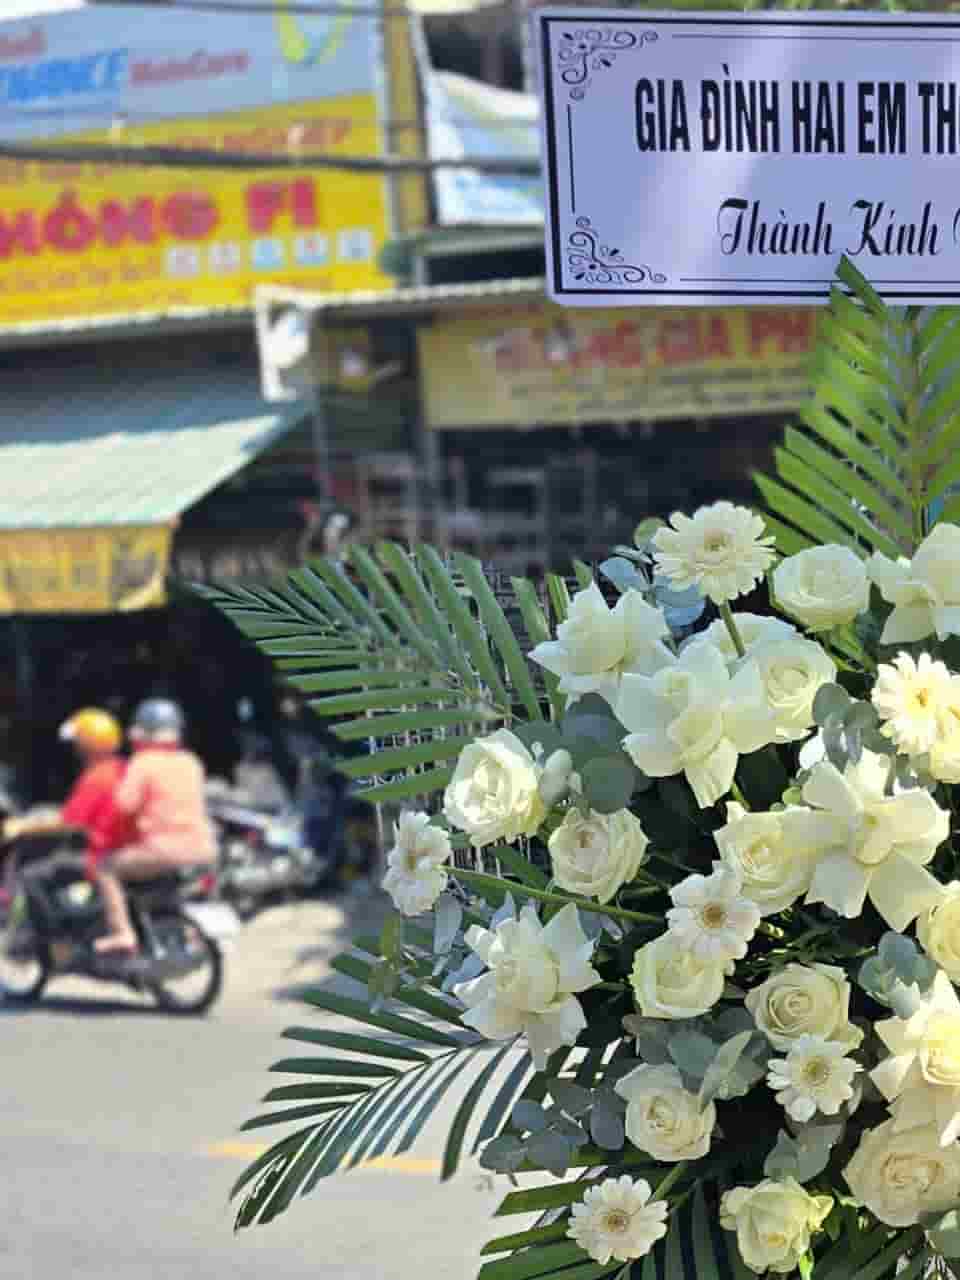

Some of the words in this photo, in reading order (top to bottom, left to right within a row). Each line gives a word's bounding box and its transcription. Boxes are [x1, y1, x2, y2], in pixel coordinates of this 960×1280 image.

[635, 77, 691, 152] GIA
[700, 63, 781, 153] ĐÌNH
[792, 80, 846, 153] HAI
[857, 81, 907, 154] EM
[717, 198, 836, 256] Thành
[848, 199, 941, 257] Kính
